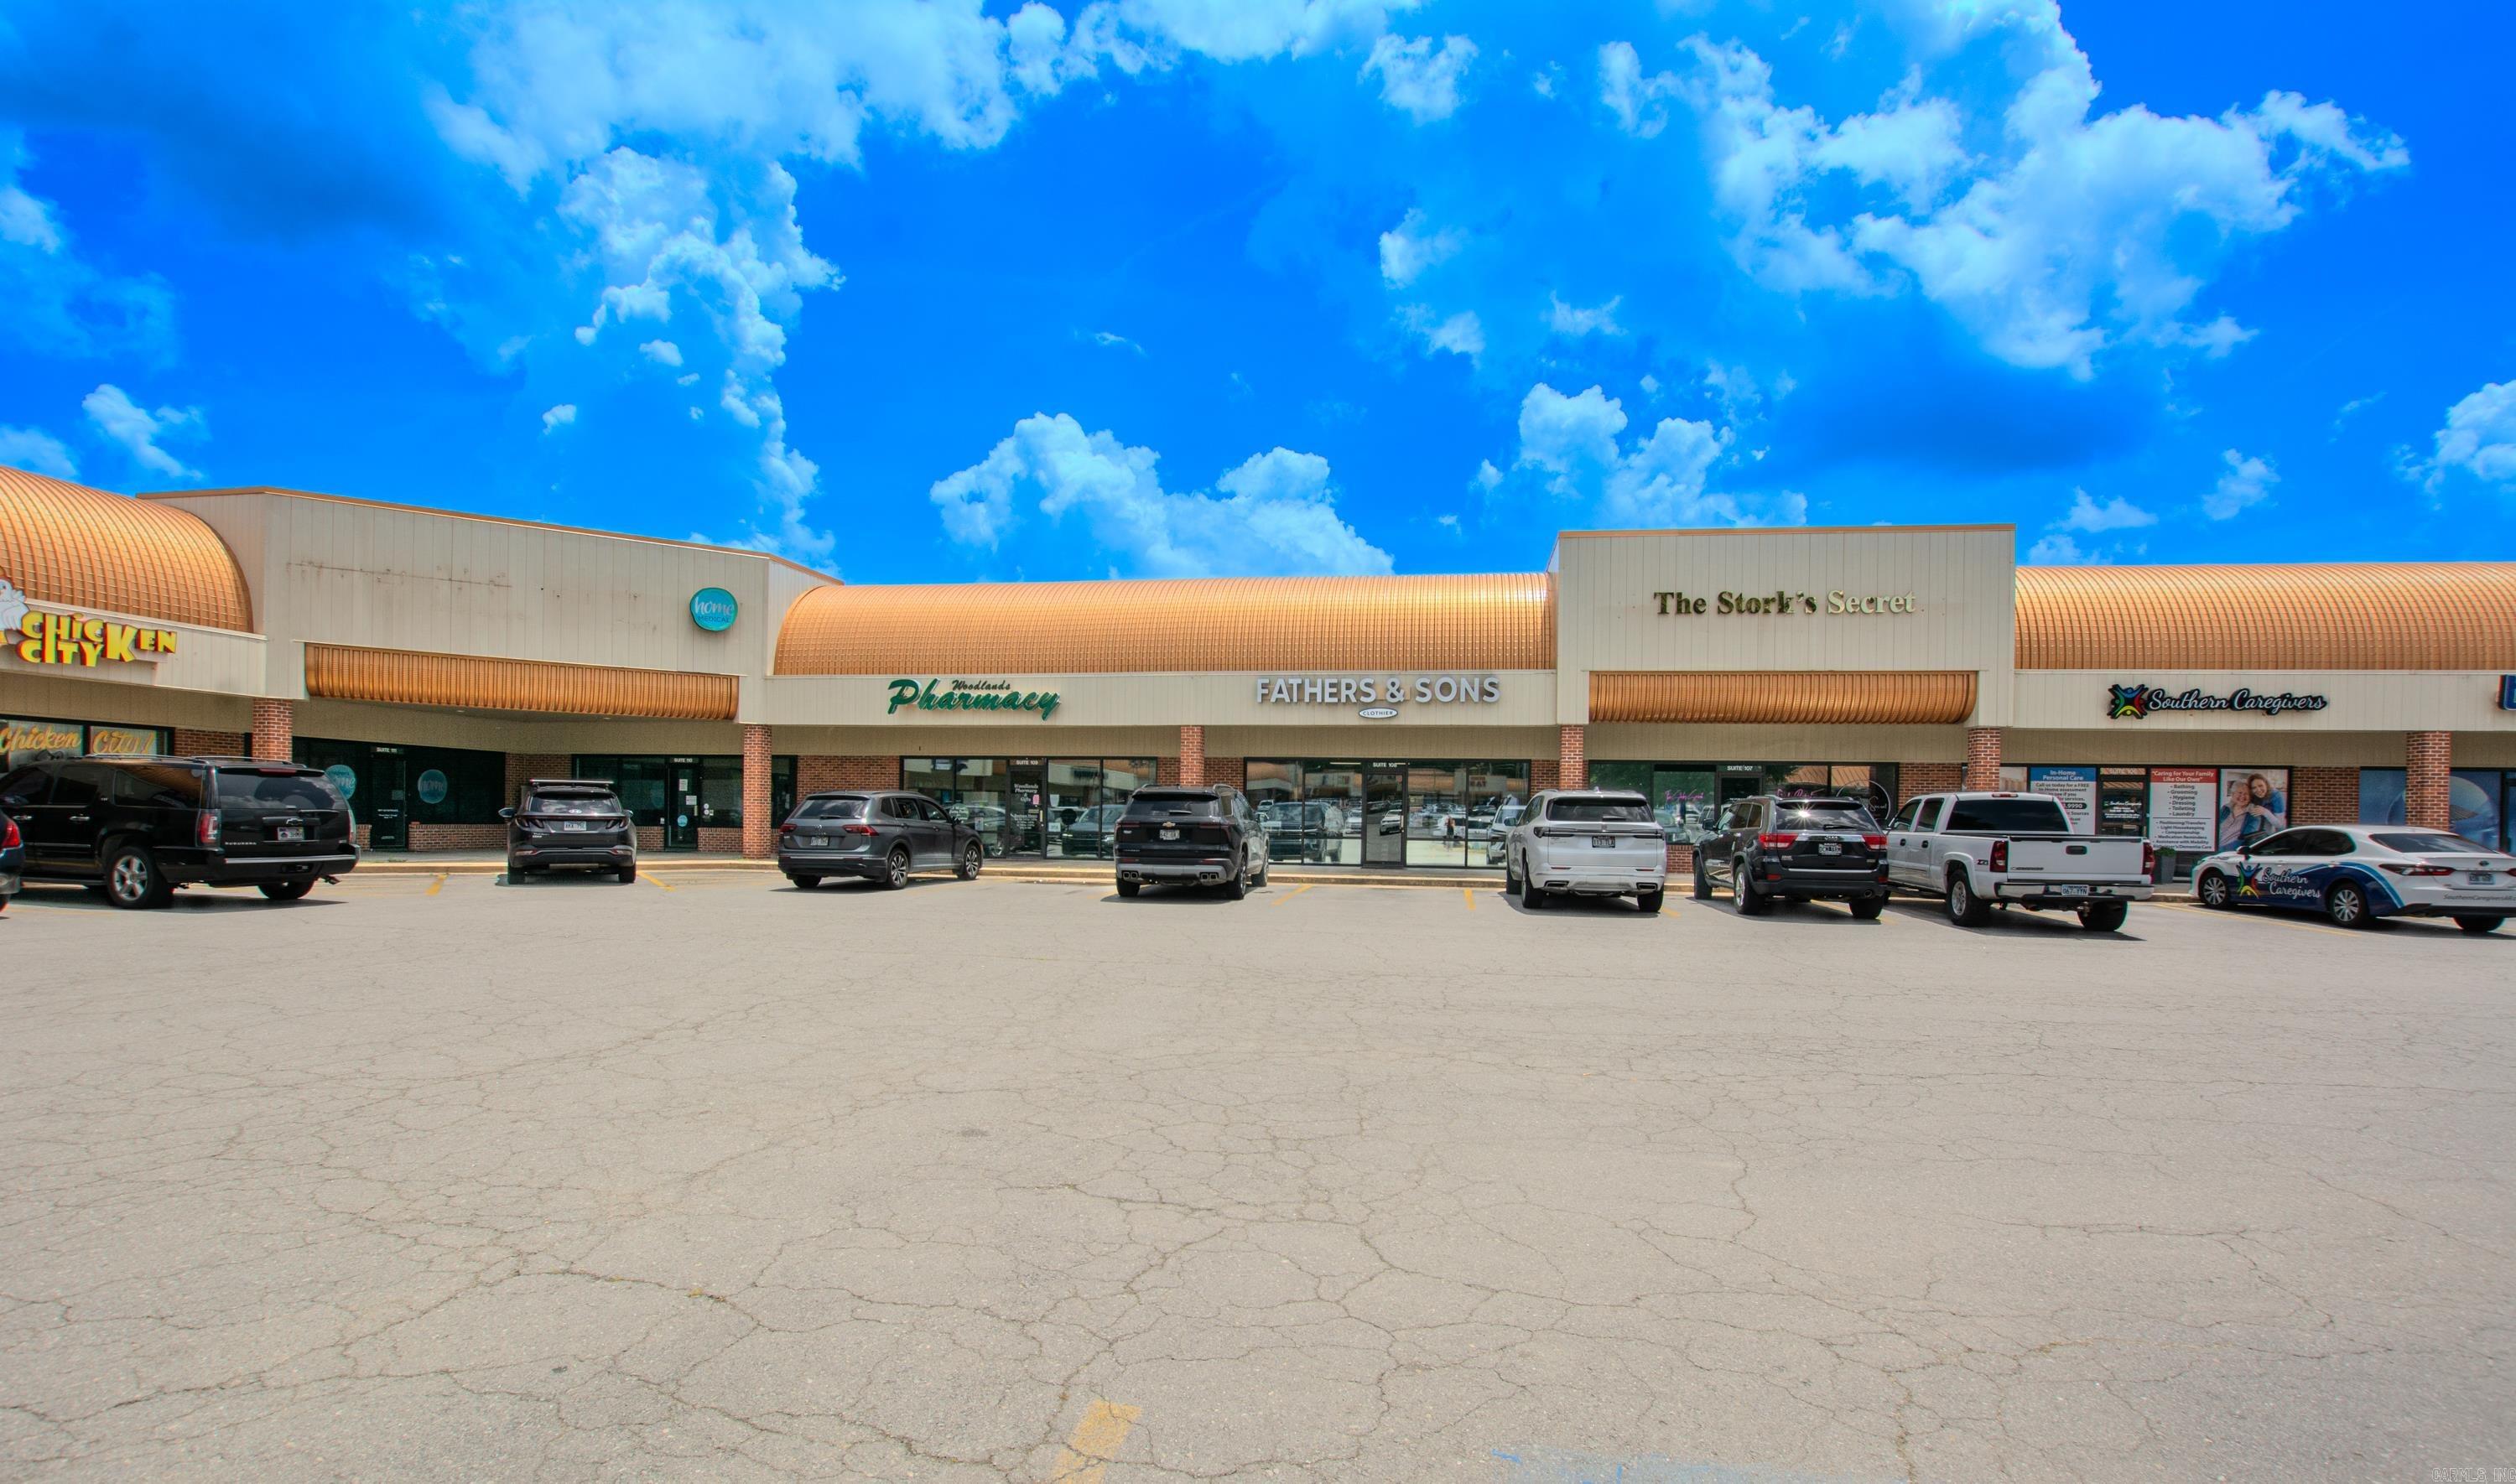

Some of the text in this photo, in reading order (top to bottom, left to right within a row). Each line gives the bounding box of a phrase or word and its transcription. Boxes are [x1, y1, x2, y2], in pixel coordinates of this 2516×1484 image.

[694, 596, 735, 616] home
[1653, 589, 1917, 615] The Stork's Secret
[951, 679, 1011, 691] Woodlands
[1256, 676, 1500, 703] FATHERS & SONS
[887, 677, 1061, 721] Pharmacy
[2148, 688, 2326, 714] Southern Caregivers
[0, 724, 156, 755] Chicken City!
[2262, 867, 2308, 884] Southern
[2269, 882, 2321, 900] Caregivers
